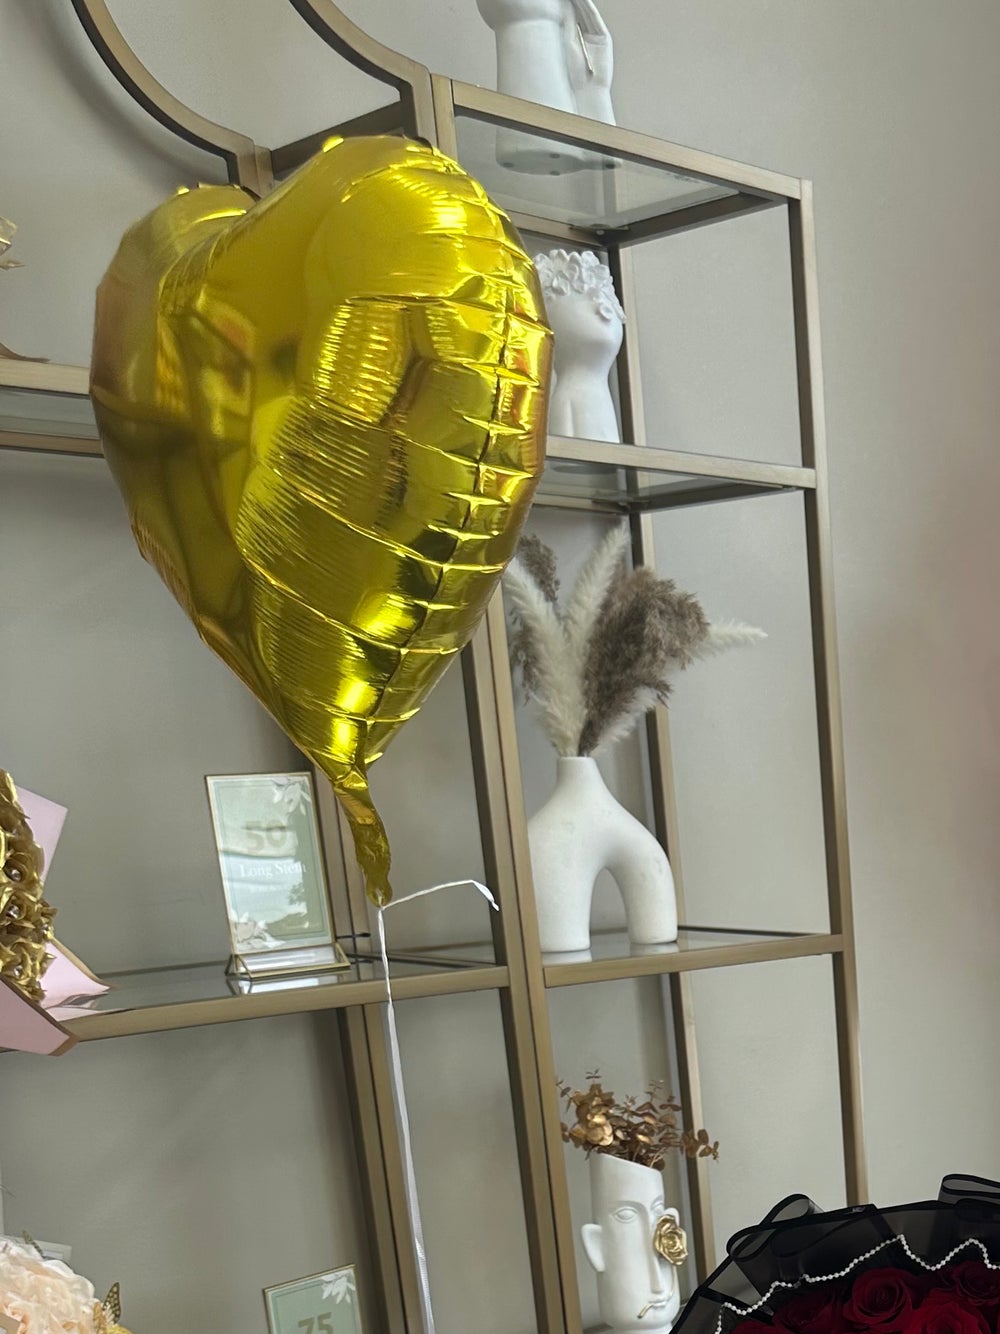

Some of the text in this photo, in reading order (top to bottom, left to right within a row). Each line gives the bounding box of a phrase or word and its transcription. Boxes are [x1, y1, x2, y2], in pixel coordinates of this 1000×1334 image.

[245, 819, 288, 851] 50
[239, 862, 307, 878] Long Stem
